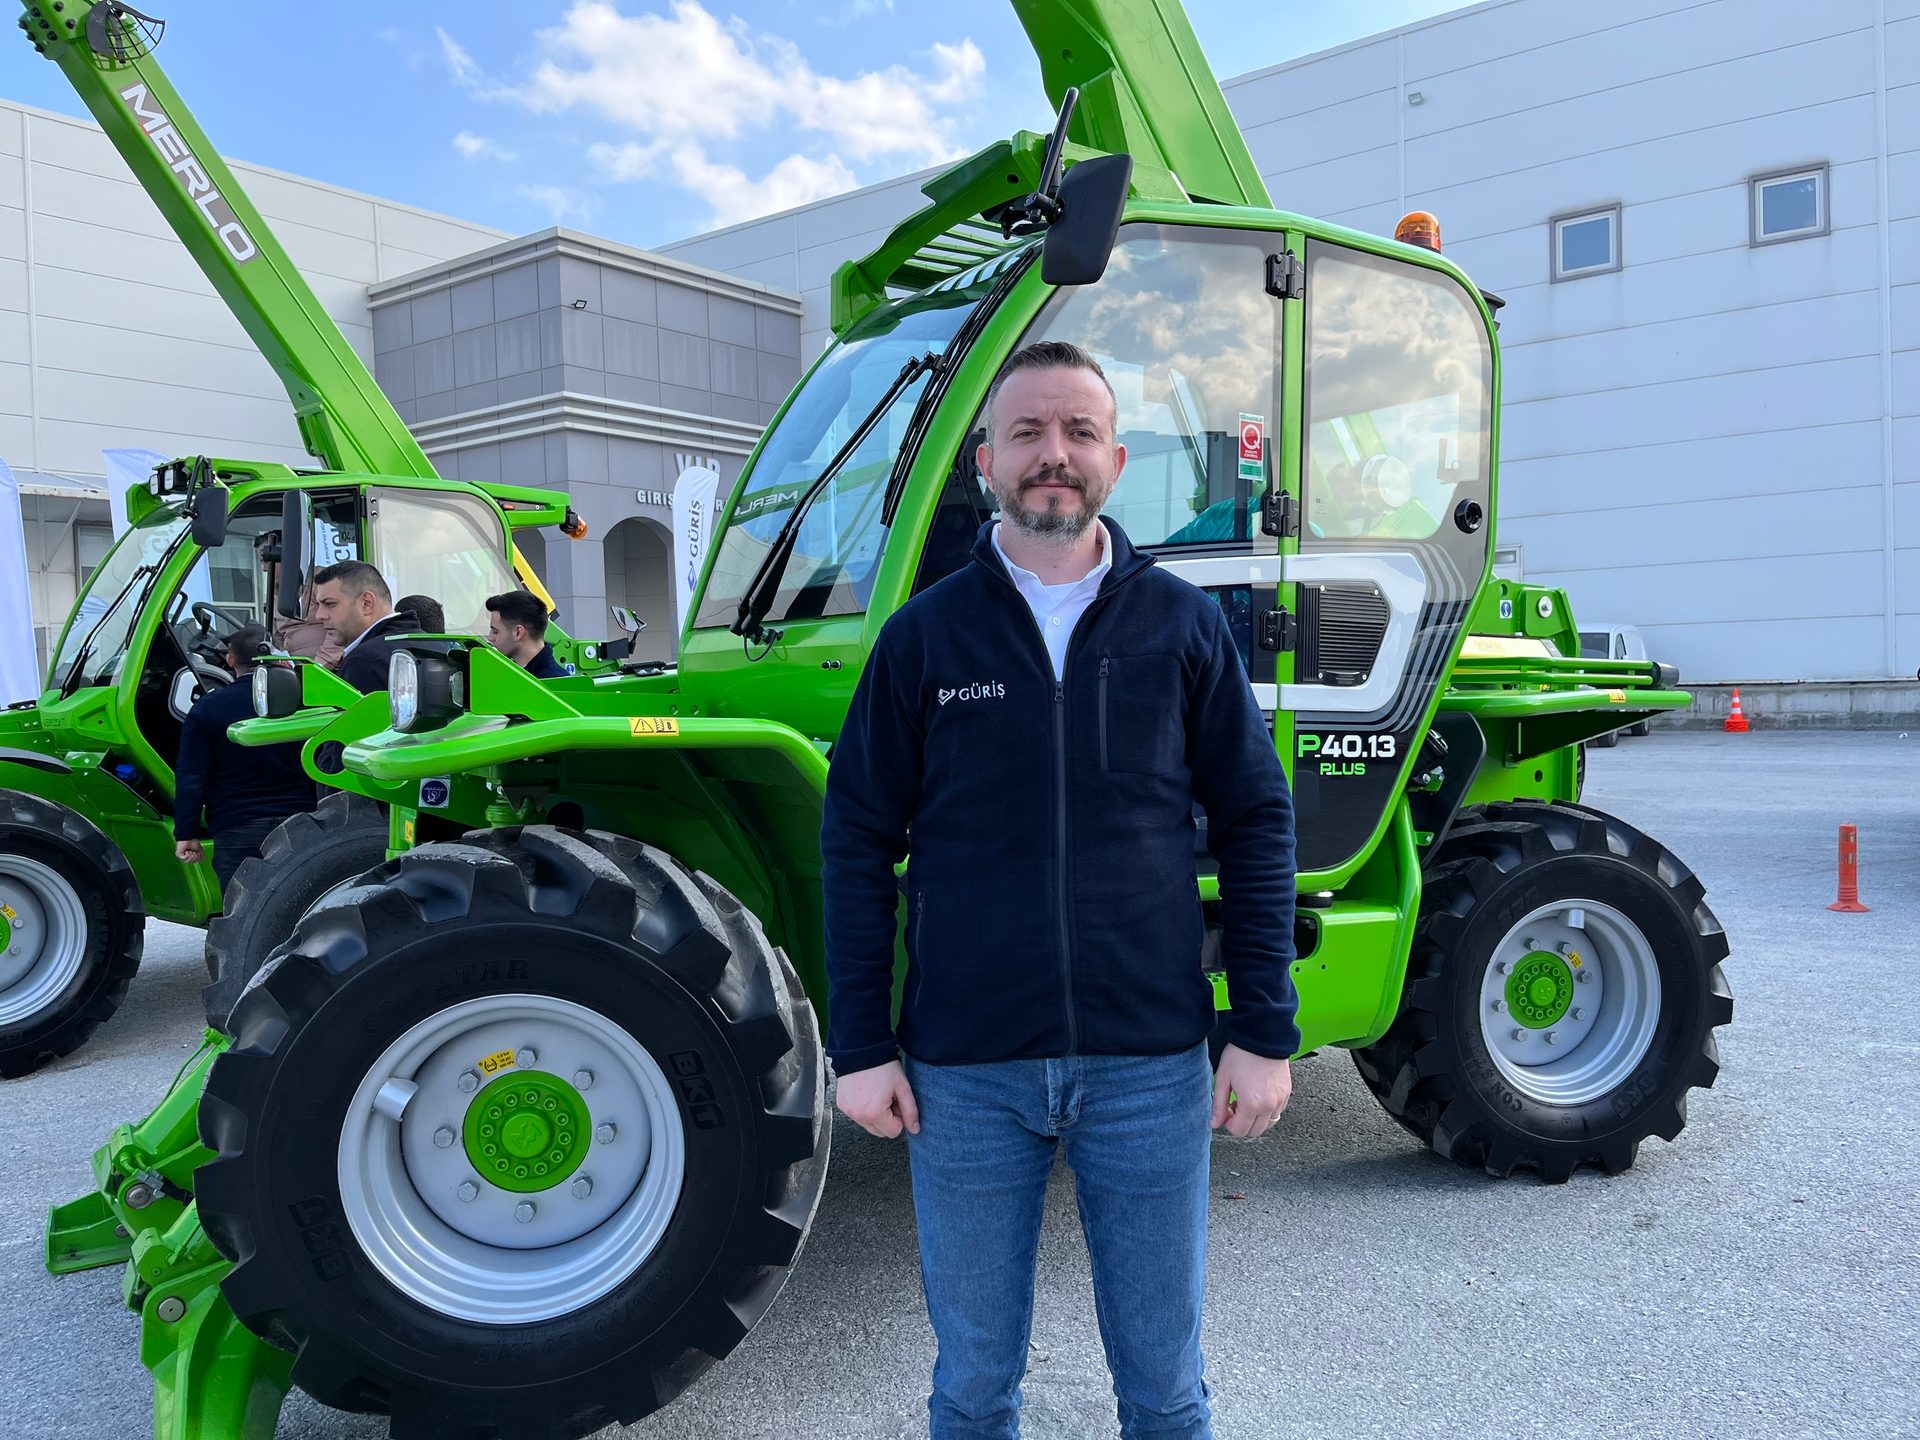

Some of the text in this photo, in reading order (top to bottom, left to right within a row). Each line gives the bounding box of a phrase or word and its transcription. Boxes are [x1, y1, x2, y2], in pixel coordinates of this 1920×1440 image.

[121, 83, 256, 261] MERLO
[688, 499, 703, 558] GÜRİŞ
[959, 680, 1005, 700] GÜRİŞ
[1320, 762, 1366, 775] PLUS
[668, 1051, 727, 1130] BKT
